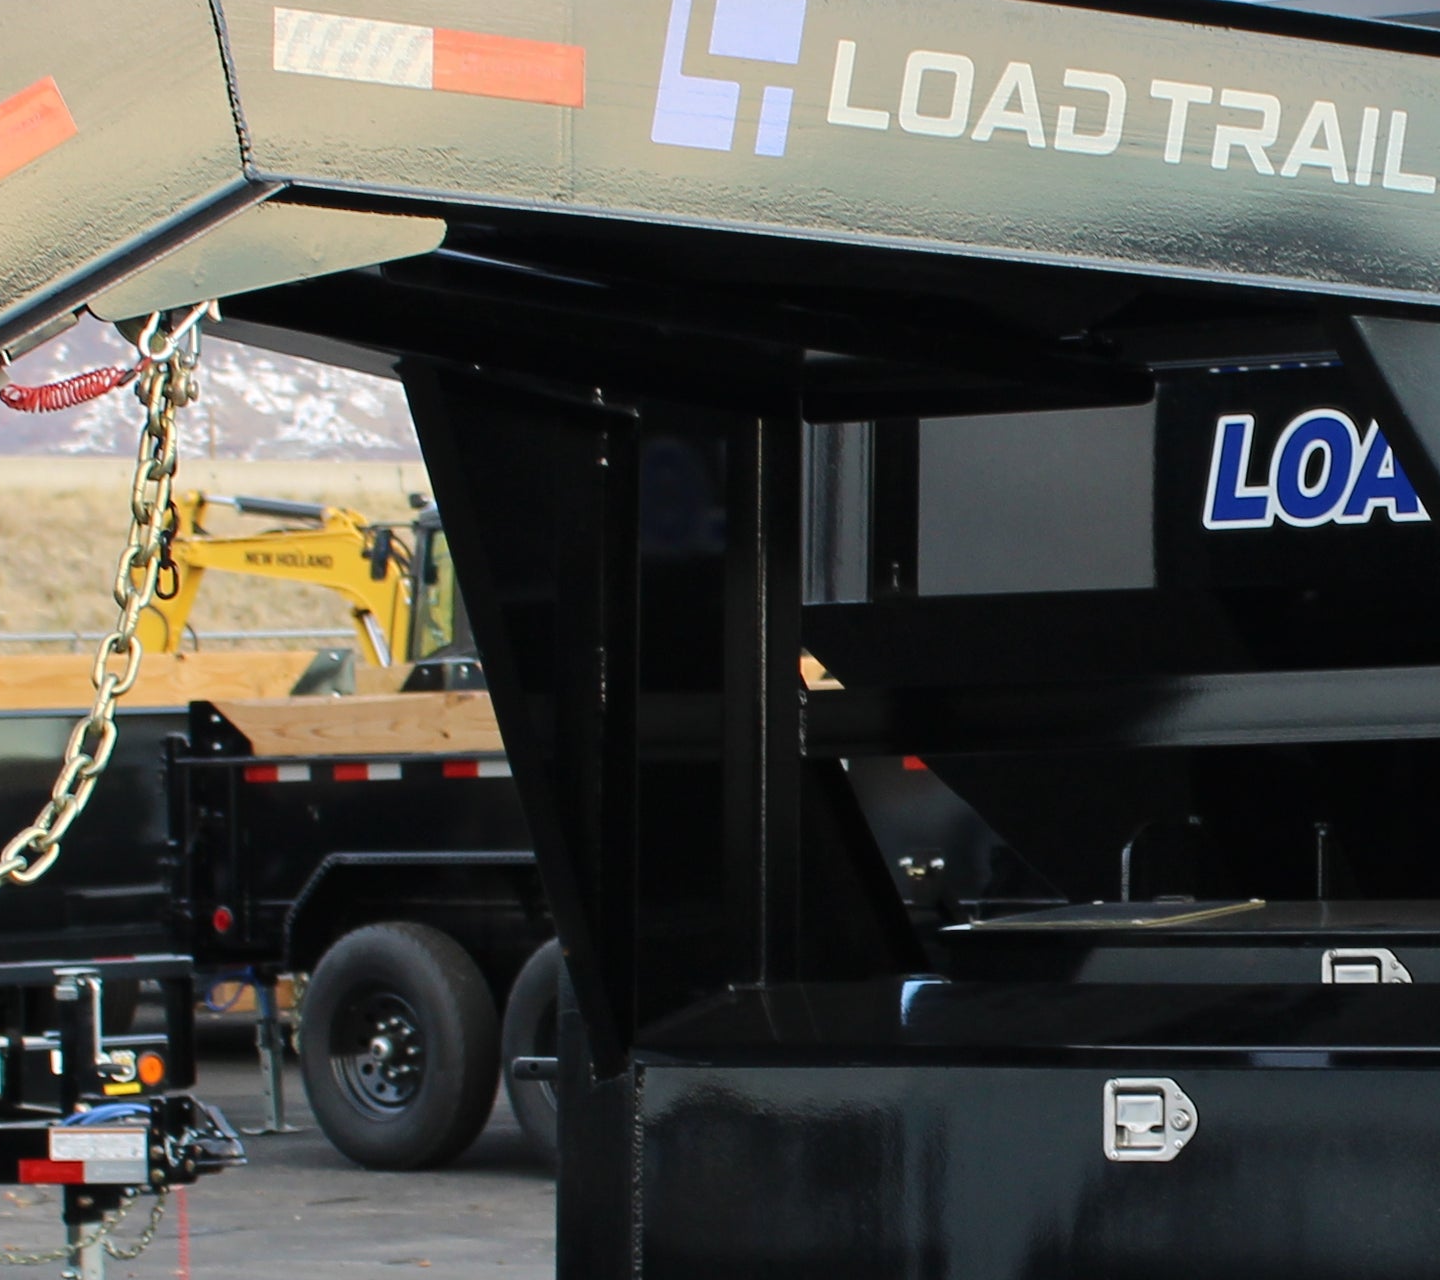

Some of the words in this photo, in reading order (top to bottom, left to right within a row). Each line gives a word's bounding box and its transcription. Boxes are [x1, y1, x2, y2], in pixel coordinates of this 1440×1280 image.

[826, 39, 1128, 156] LOAD
[1150, 79, 1437, 194] TRAIL
[1203, 408, 1431, 530] LOA
[245, 551, 273, 565] NEW
[276, 552, 334, 569] HOLLAND
